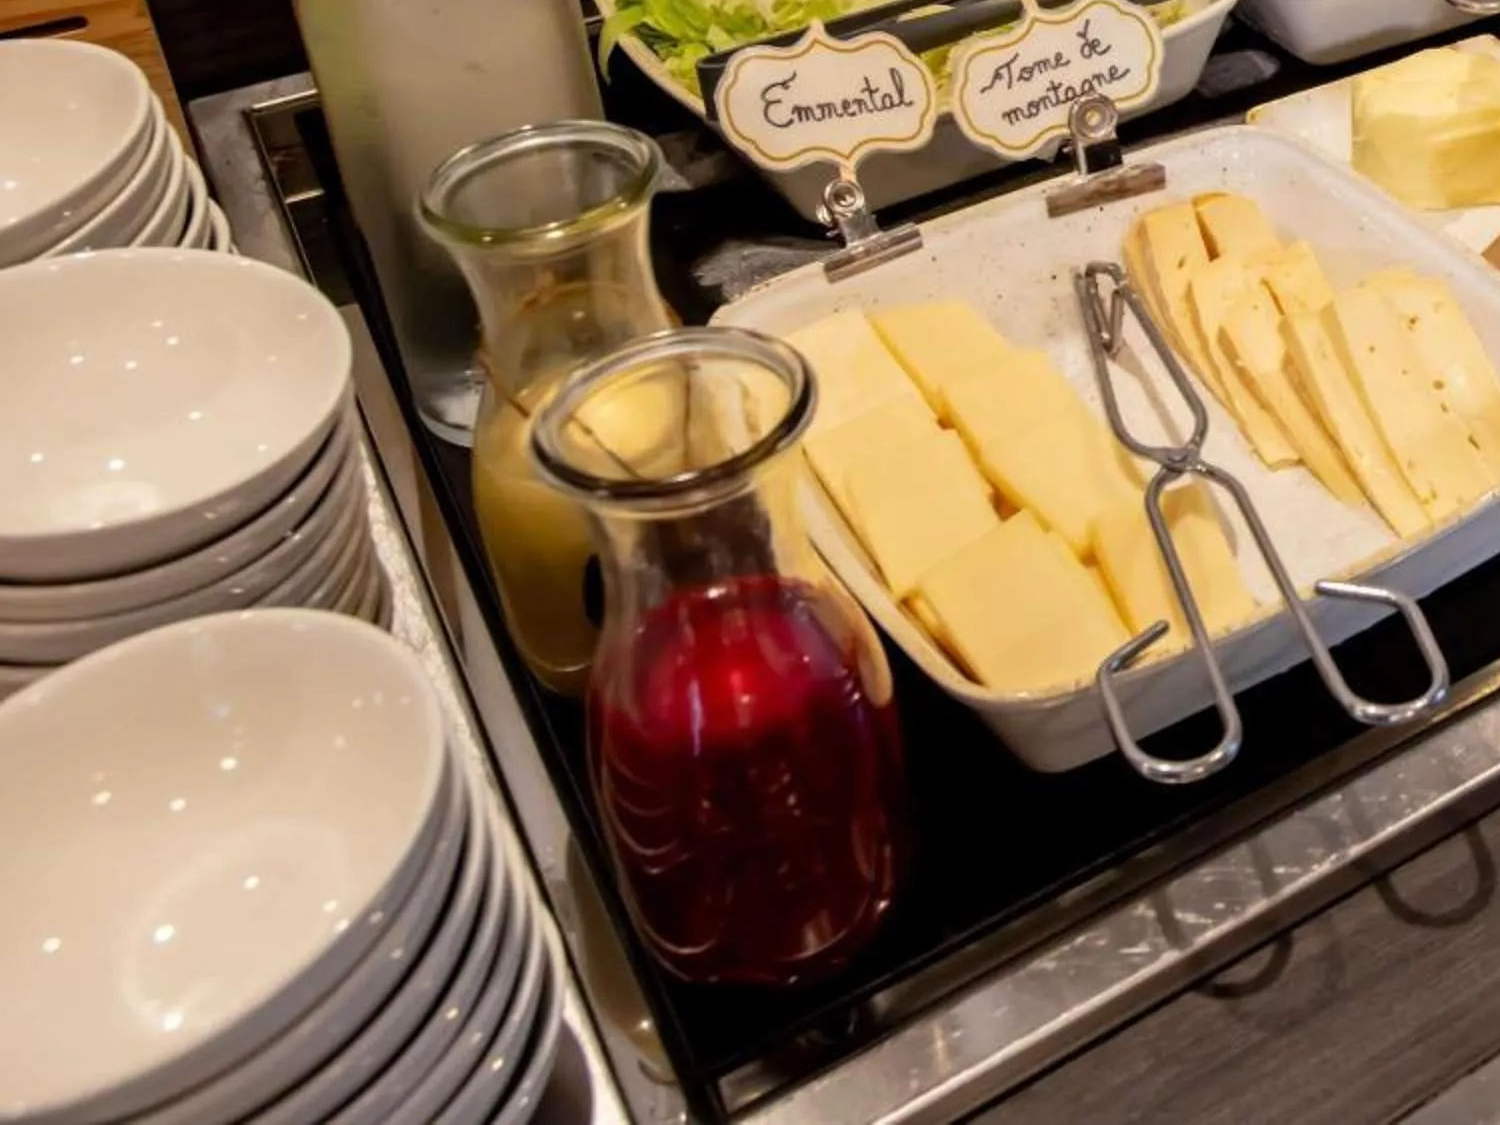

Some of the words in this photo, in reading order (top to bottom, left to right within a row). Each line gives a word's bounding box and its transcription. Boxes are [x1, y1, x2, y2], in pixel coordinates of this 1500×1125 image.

[980, 52, 1071, 94] Tome
[1076, 19, 1112, 59] de
[760, 67, 914, 129] Emmental
